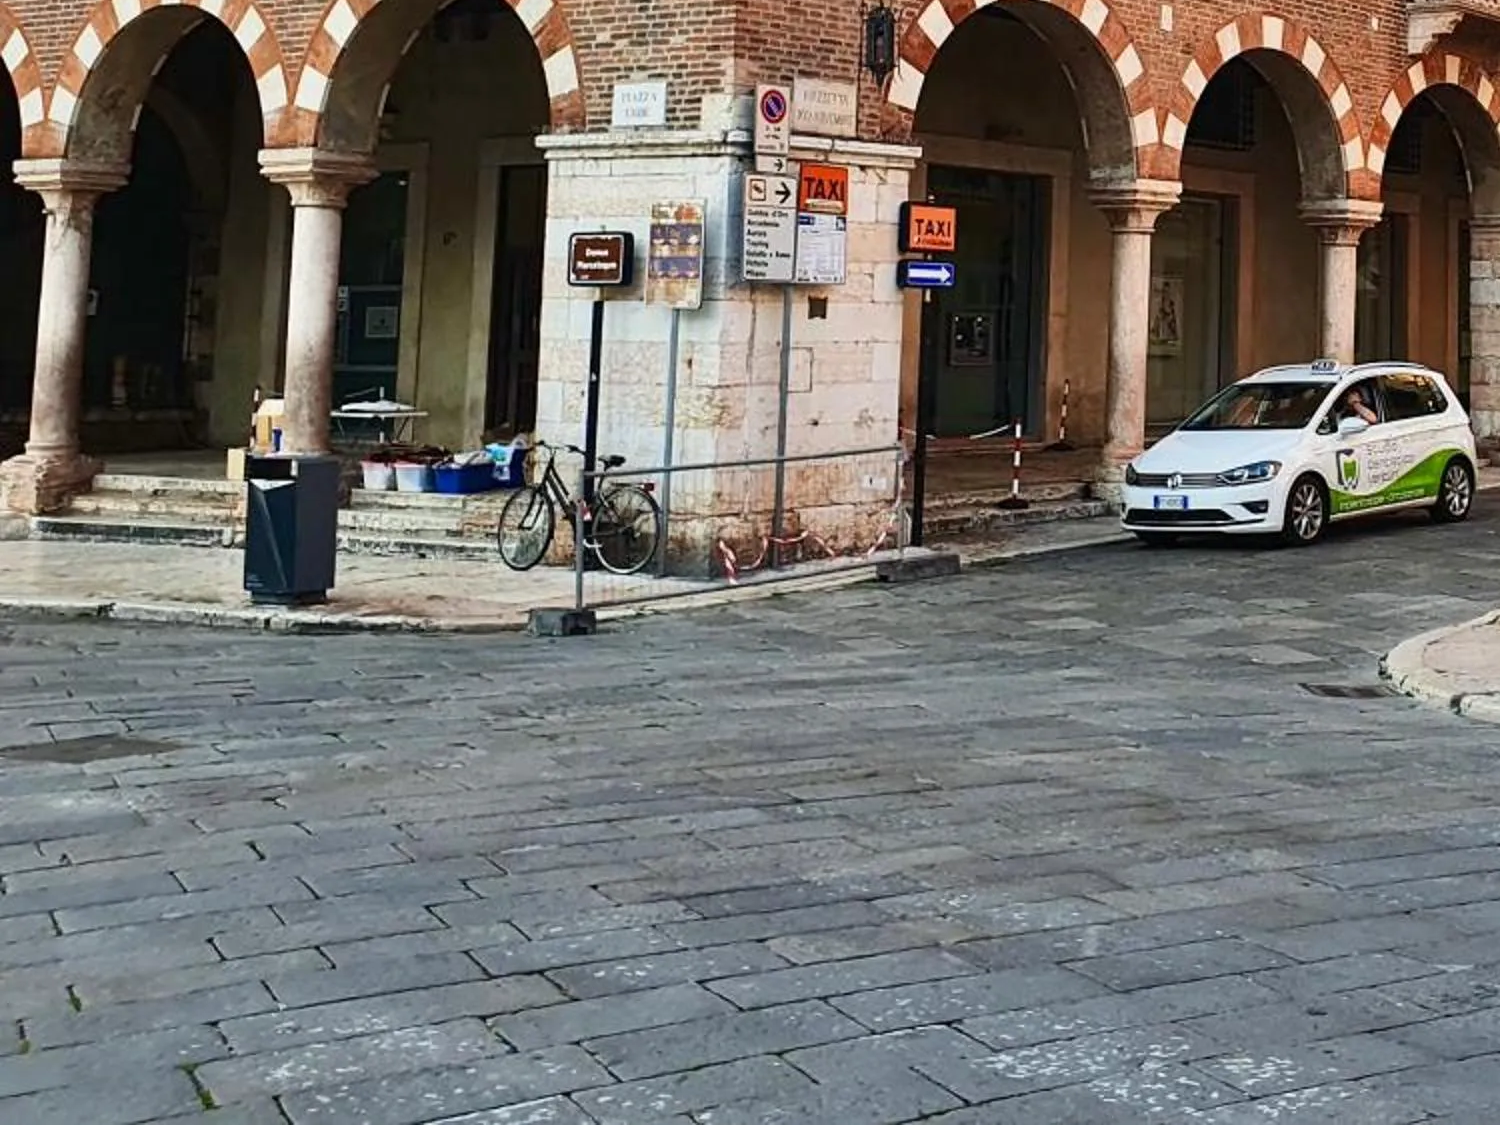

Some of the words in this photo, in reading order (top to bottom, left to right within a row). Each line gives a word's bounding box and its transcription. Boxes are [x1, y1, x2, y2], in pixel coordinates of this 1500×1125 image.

[622, 91, 657, 104] PIAZZA
[804, 177, 845, 201] TAXI
[914, 218, 951, 238] TAXI
